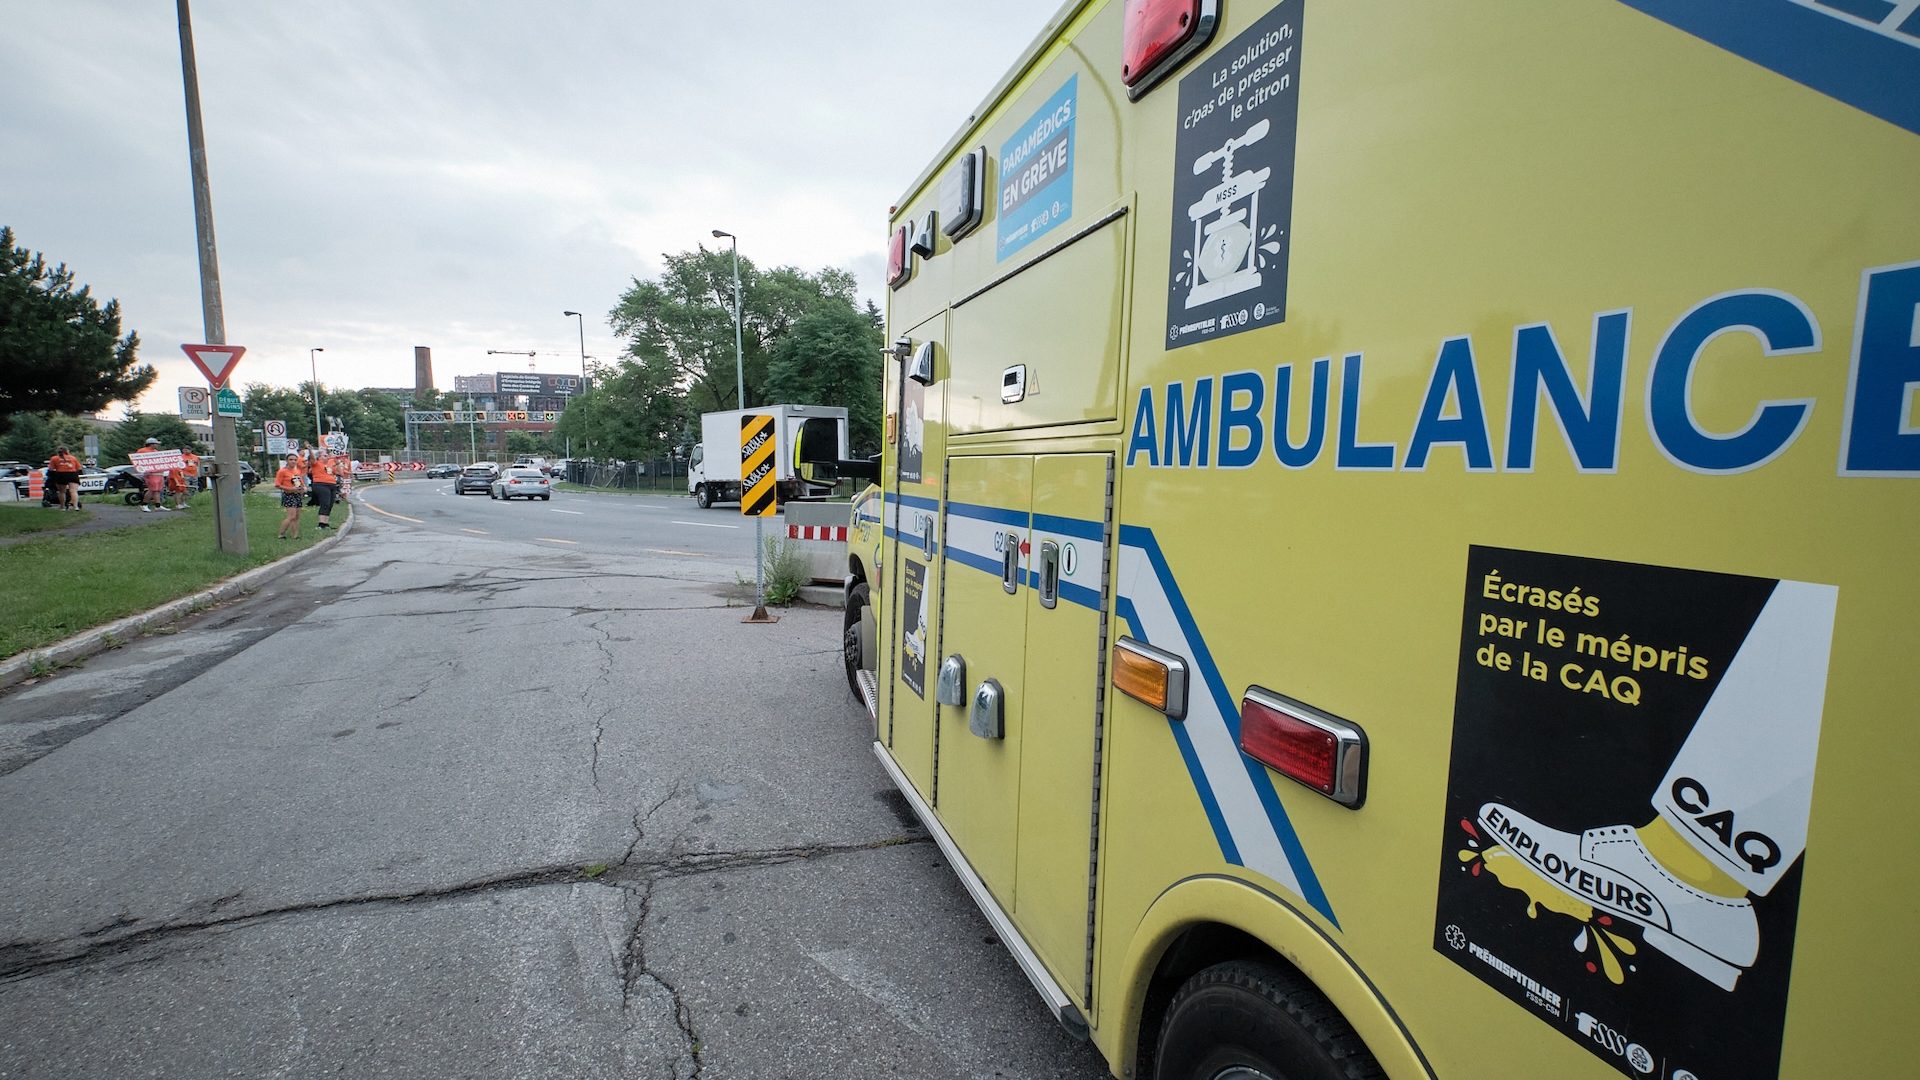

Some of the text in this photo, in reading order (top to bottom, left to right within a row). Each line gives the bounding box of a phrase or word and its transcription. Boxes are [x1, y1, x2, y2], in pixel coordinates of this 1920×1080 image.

[1184, 46, 1293, 130] c'pas de presser
[1212, 23, 1293, 88] La solution,
[1231, 73, 1290, 122] le citron
[1002, 99, 1072, 176] PARAMÉDICS
[1002, 138, 1068, 212] EN GRÈVE
[1216, 185, 1238, 203] MSSS
[1482, 569, 1600, 617] Écrasés
[1476, 643, 1642, 706] de la CAQ
[1478, 612, 1709, 680] par le mépris
[1671, 776, 1782, 875] CAQ
[1486, 807, 1653, 916] EMPLOYEURS
[1526, 990, 1560, 1018] FSSS-CSN
